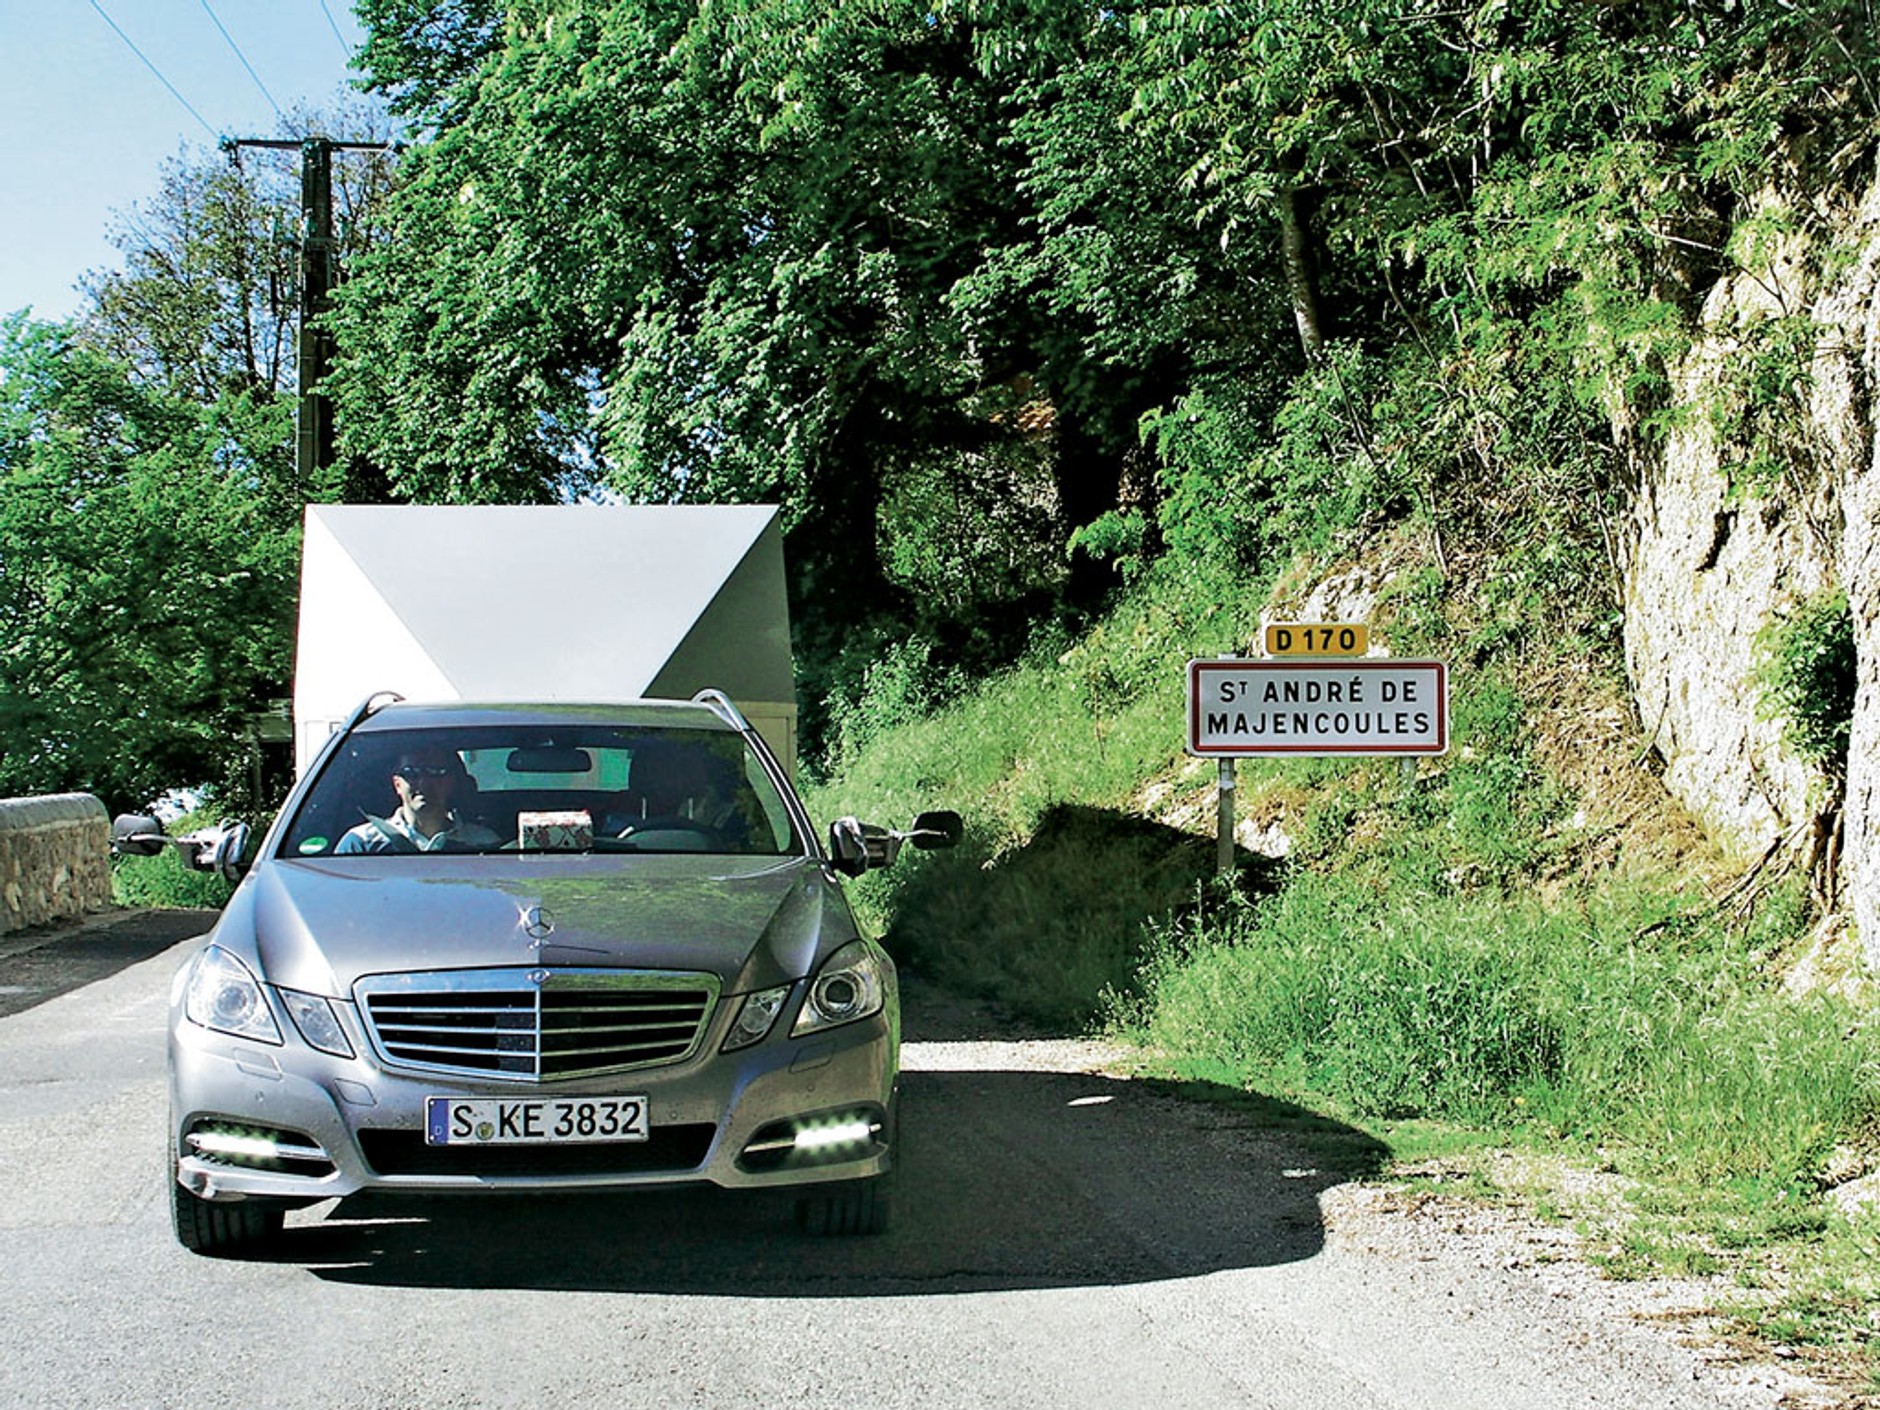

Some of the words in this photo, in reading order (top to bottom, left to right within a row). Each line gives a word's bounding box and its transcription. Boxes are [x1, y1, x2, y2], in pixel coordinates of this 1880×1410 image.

[1276, 630, 1292, 650] D
[1303, 629, 1355, 650] 170
[1263, 676, 1363, 702] ANDRÉ
[1382, 681, 1417, 702] DE
[1208, 713, 1429, 734] MAJENCOULES
[452, 1105, 473, 1137] S
[499, 1104, 544, 1137] KE
[554, 1102, 640, 1136] 3832
